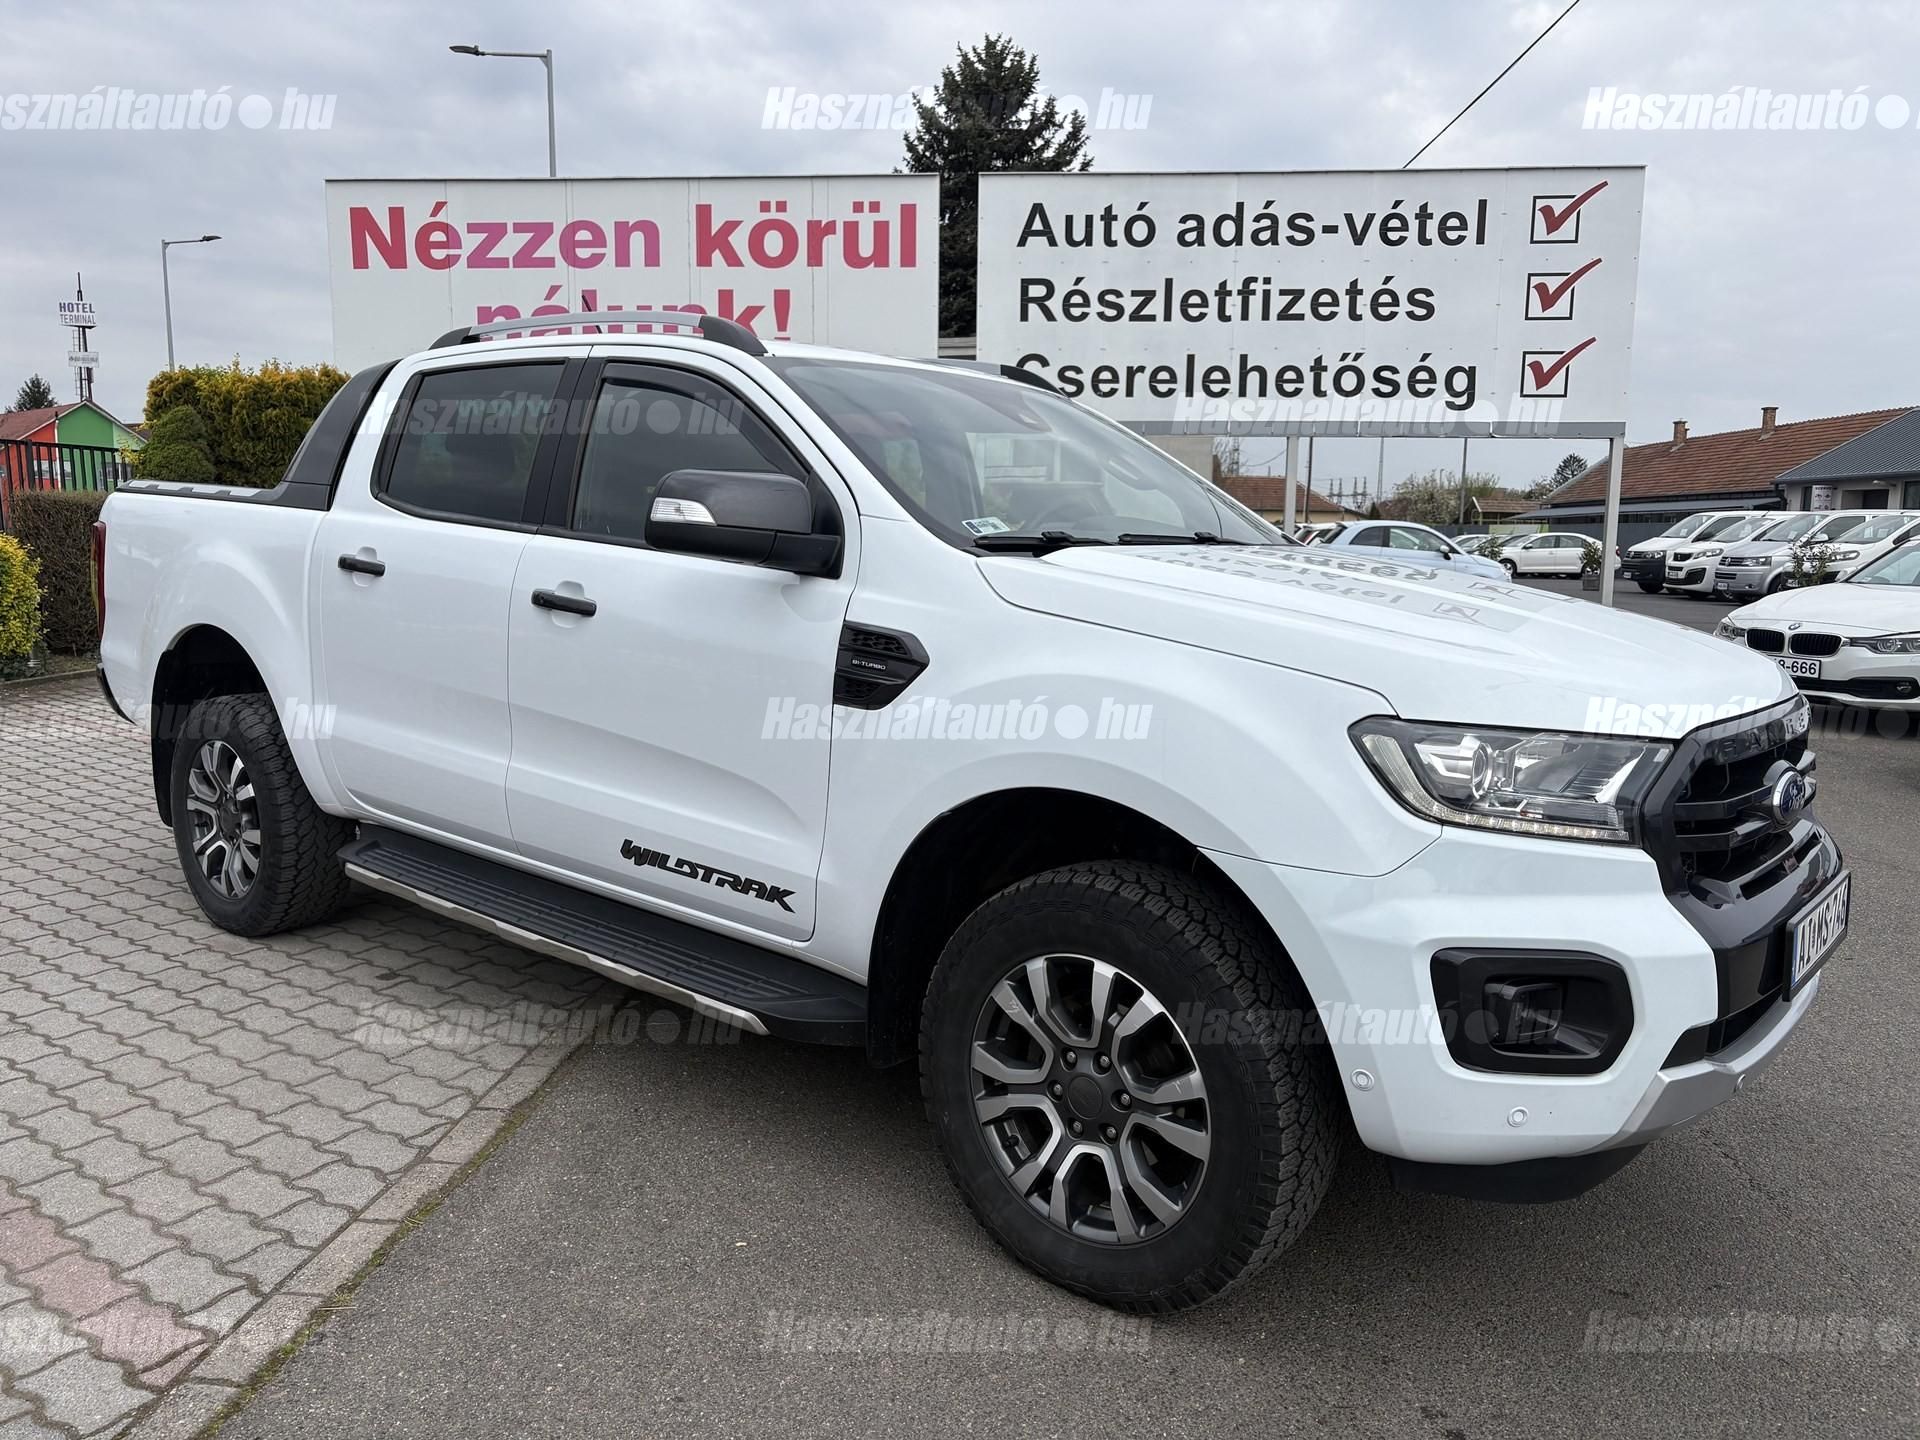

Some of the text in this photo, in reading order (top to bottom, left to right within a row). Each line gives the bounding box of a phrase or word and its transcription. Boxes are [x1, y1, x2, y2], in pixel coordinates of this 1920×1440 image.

[349, 200, 917, 270] Nézzen körül
[1016, 199, 1488, 248] Autó adás-vétel
[59, 302, 96, 314] HOTEL
[60, 314, 97, 325] TERMINAL
[1019, 275, 1436, 323] Részletfizetés
[852, 659, 886, 670] BI-TURBO
[620, 838, 796, 914] WILDTRAK
